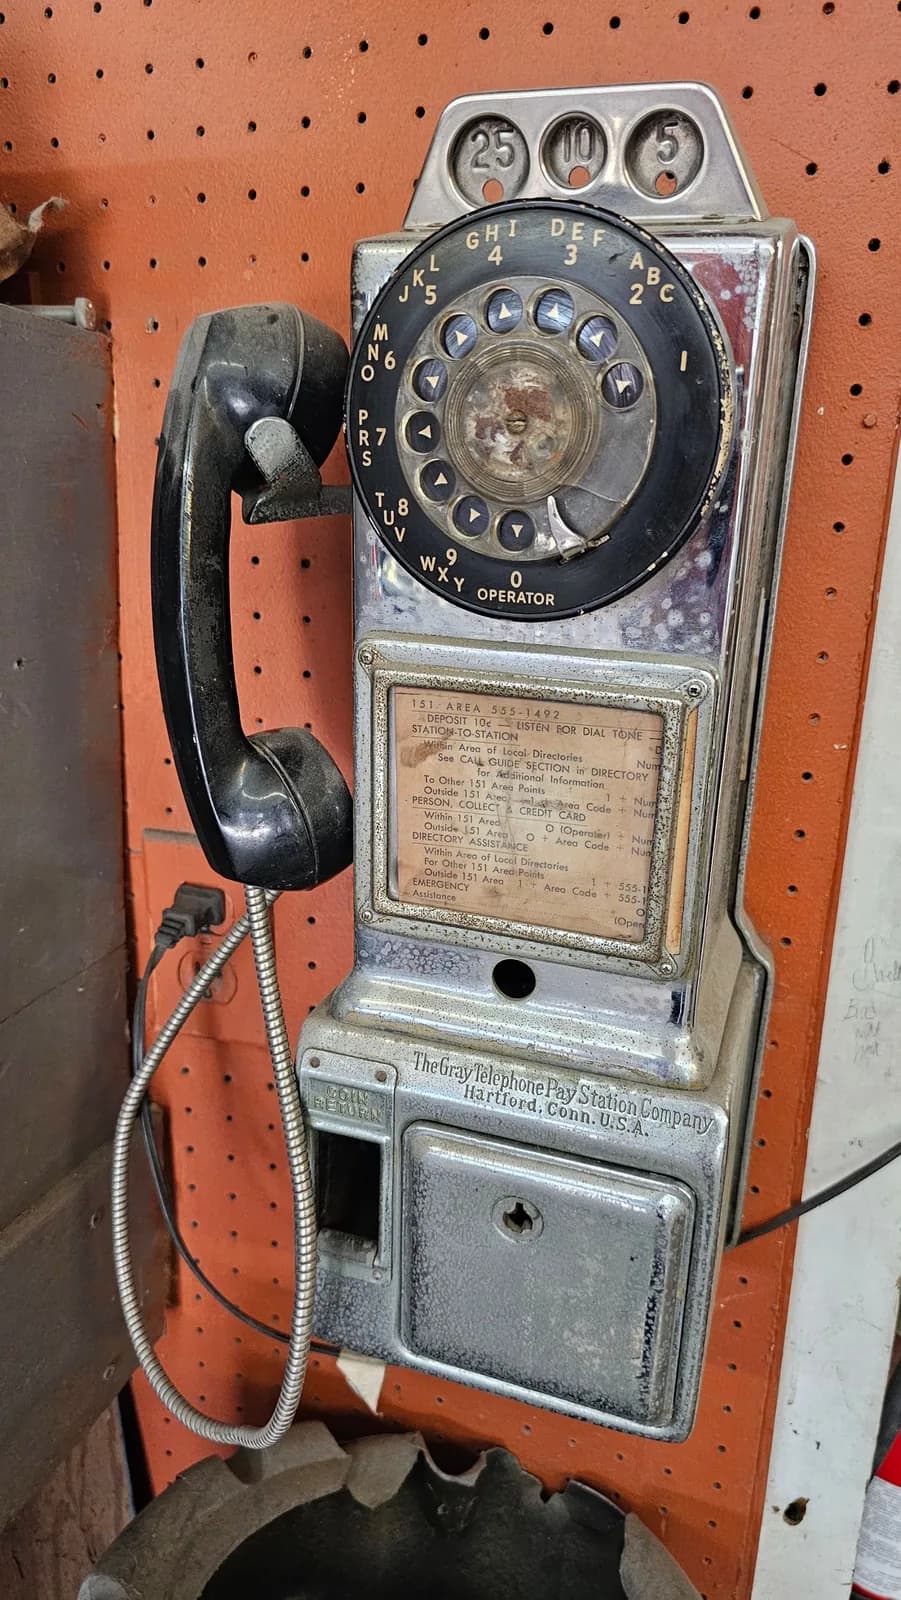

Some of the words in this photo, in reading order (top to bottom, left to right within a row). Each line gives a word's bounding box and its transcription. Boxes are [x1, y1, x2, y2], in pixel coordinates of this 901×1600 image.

[471, 126, 515, 170] 25
[561, 120, 593, 162] 10
[656, 120, 680, 163] 5
[488, 245, 503, 266] 4
[564, 244, 578, 265] 3
[424, 285, 437, 305] 5
[629, 283, 644, 305] 2
[384, 350, 396, 370] 6
[375, 427, 387, 447] 7
[397, 498, 409, 517] 8
[445, 548, 458, 567] 9
[477, 588, 555, 606] OPERATOR
[411, 698, 434, 710] 151
[446, 701, 482, 714] AREA
[490, 704, 560, 720] 555-1492
[411, 724, 519, 742] STATION-TO-STATION
[427, 713, 468, 726] DEPOSIT
[516, 721, 550, 733] LISTEN
[556, 724, 577, 736] FOR
[582, 727, 606, 738] DIAL
[612, 729, 643, 741] TONE
[423, 740, 453, 751] Within
[458, 743, 481, 753] Area
[486, 746, 497, 755] of
[503, 747, 527, 758] Local
[532, 749, 583, 763] Directories
[437, 752, 454, 763] See
[459, 754, 484, 767] CALL
[488, 757, 520, 769] GUIDE
[525, 760, 570, 774] SECTION
[576, 765, 585, 775] in
[591, 767, 648, 782] DIRECTORY
[477, 767, 490, 777] for
[495, 769, 544, 783] Additional
[550, 775, 605, 790] Information
[423, 774, 435, 784] To
[438, 775, 465, 787] Other
[470, 778, 486, 789] 151
[491, 781, 514, 792] Area
[518, 783, 546, 795] Points
[412, 795, 453, 809] PERSON,
[458, 800, 500, 813] COLLECT
[519, 806, 553, 819] CREDIT
[558, 810, 586, 823] CARD
[423, 785, 459, 798] Outside
[463, 789, 480, 799] 151
[485, 792, 508, 802] Area
[556, 799, 580, 811] Area
[586, 802, 612, 814] Code
[423, 810, 453, 821] Within
[457, 814, 474, 825] 151
[478, 816, 501, 827] Area
[560, 824, 611, 840] (Operator)
[423, 821, 459, 833] Outside
[463, 826, 481, 836] 151
[486, 828, 509, 840] Area
[555, 837, 579, 848] Area
[584, 840, 610, 852] Code
[412, 831, 464, 845] DIRECTORY
[469, 837, 529, 853] ASSISTANCE
[423, 846, 453, 858] Within
[456, 850, 478, 861] Area
[481, 853, 492, 863] of
[494, 854, 518, 866] Local
[520, 857, 569, 872] Directories
[424, 857, 438, 867] For
[442, 859, 467, 870] Other
[471, 862, 488, 873] 151
[492, 865, 514, 876] Area
[518, 868, 545, 880] Points
[413, 877, 470, 893] EMERGENCY
[424, 868, 459, 880] Outside
[462, 871, 478, 882] 151
[483, 874, 505, 886] Area
[543, 883, 567, 895] Area
[571, 886, 598, 899] Code
[412, 889, 457, 902] Assistance
[414, 1050, 438, 1074] The
[439, 1056, 473, 1085] Gray
[474, 1062, 545, 1096] Telephone
[545, 1077, 578, 1106] Pay
[578, 1084, 638, 1117] Station
[640, 1097, 714, 1136] Company
[313, 1096, 382, 1121] RETURN
[463, 1083, 542, 1114] Hartford,
[547, 1101, 596, 1126] Conn.
[599, 1110, 650, 1138] U.S.A.
